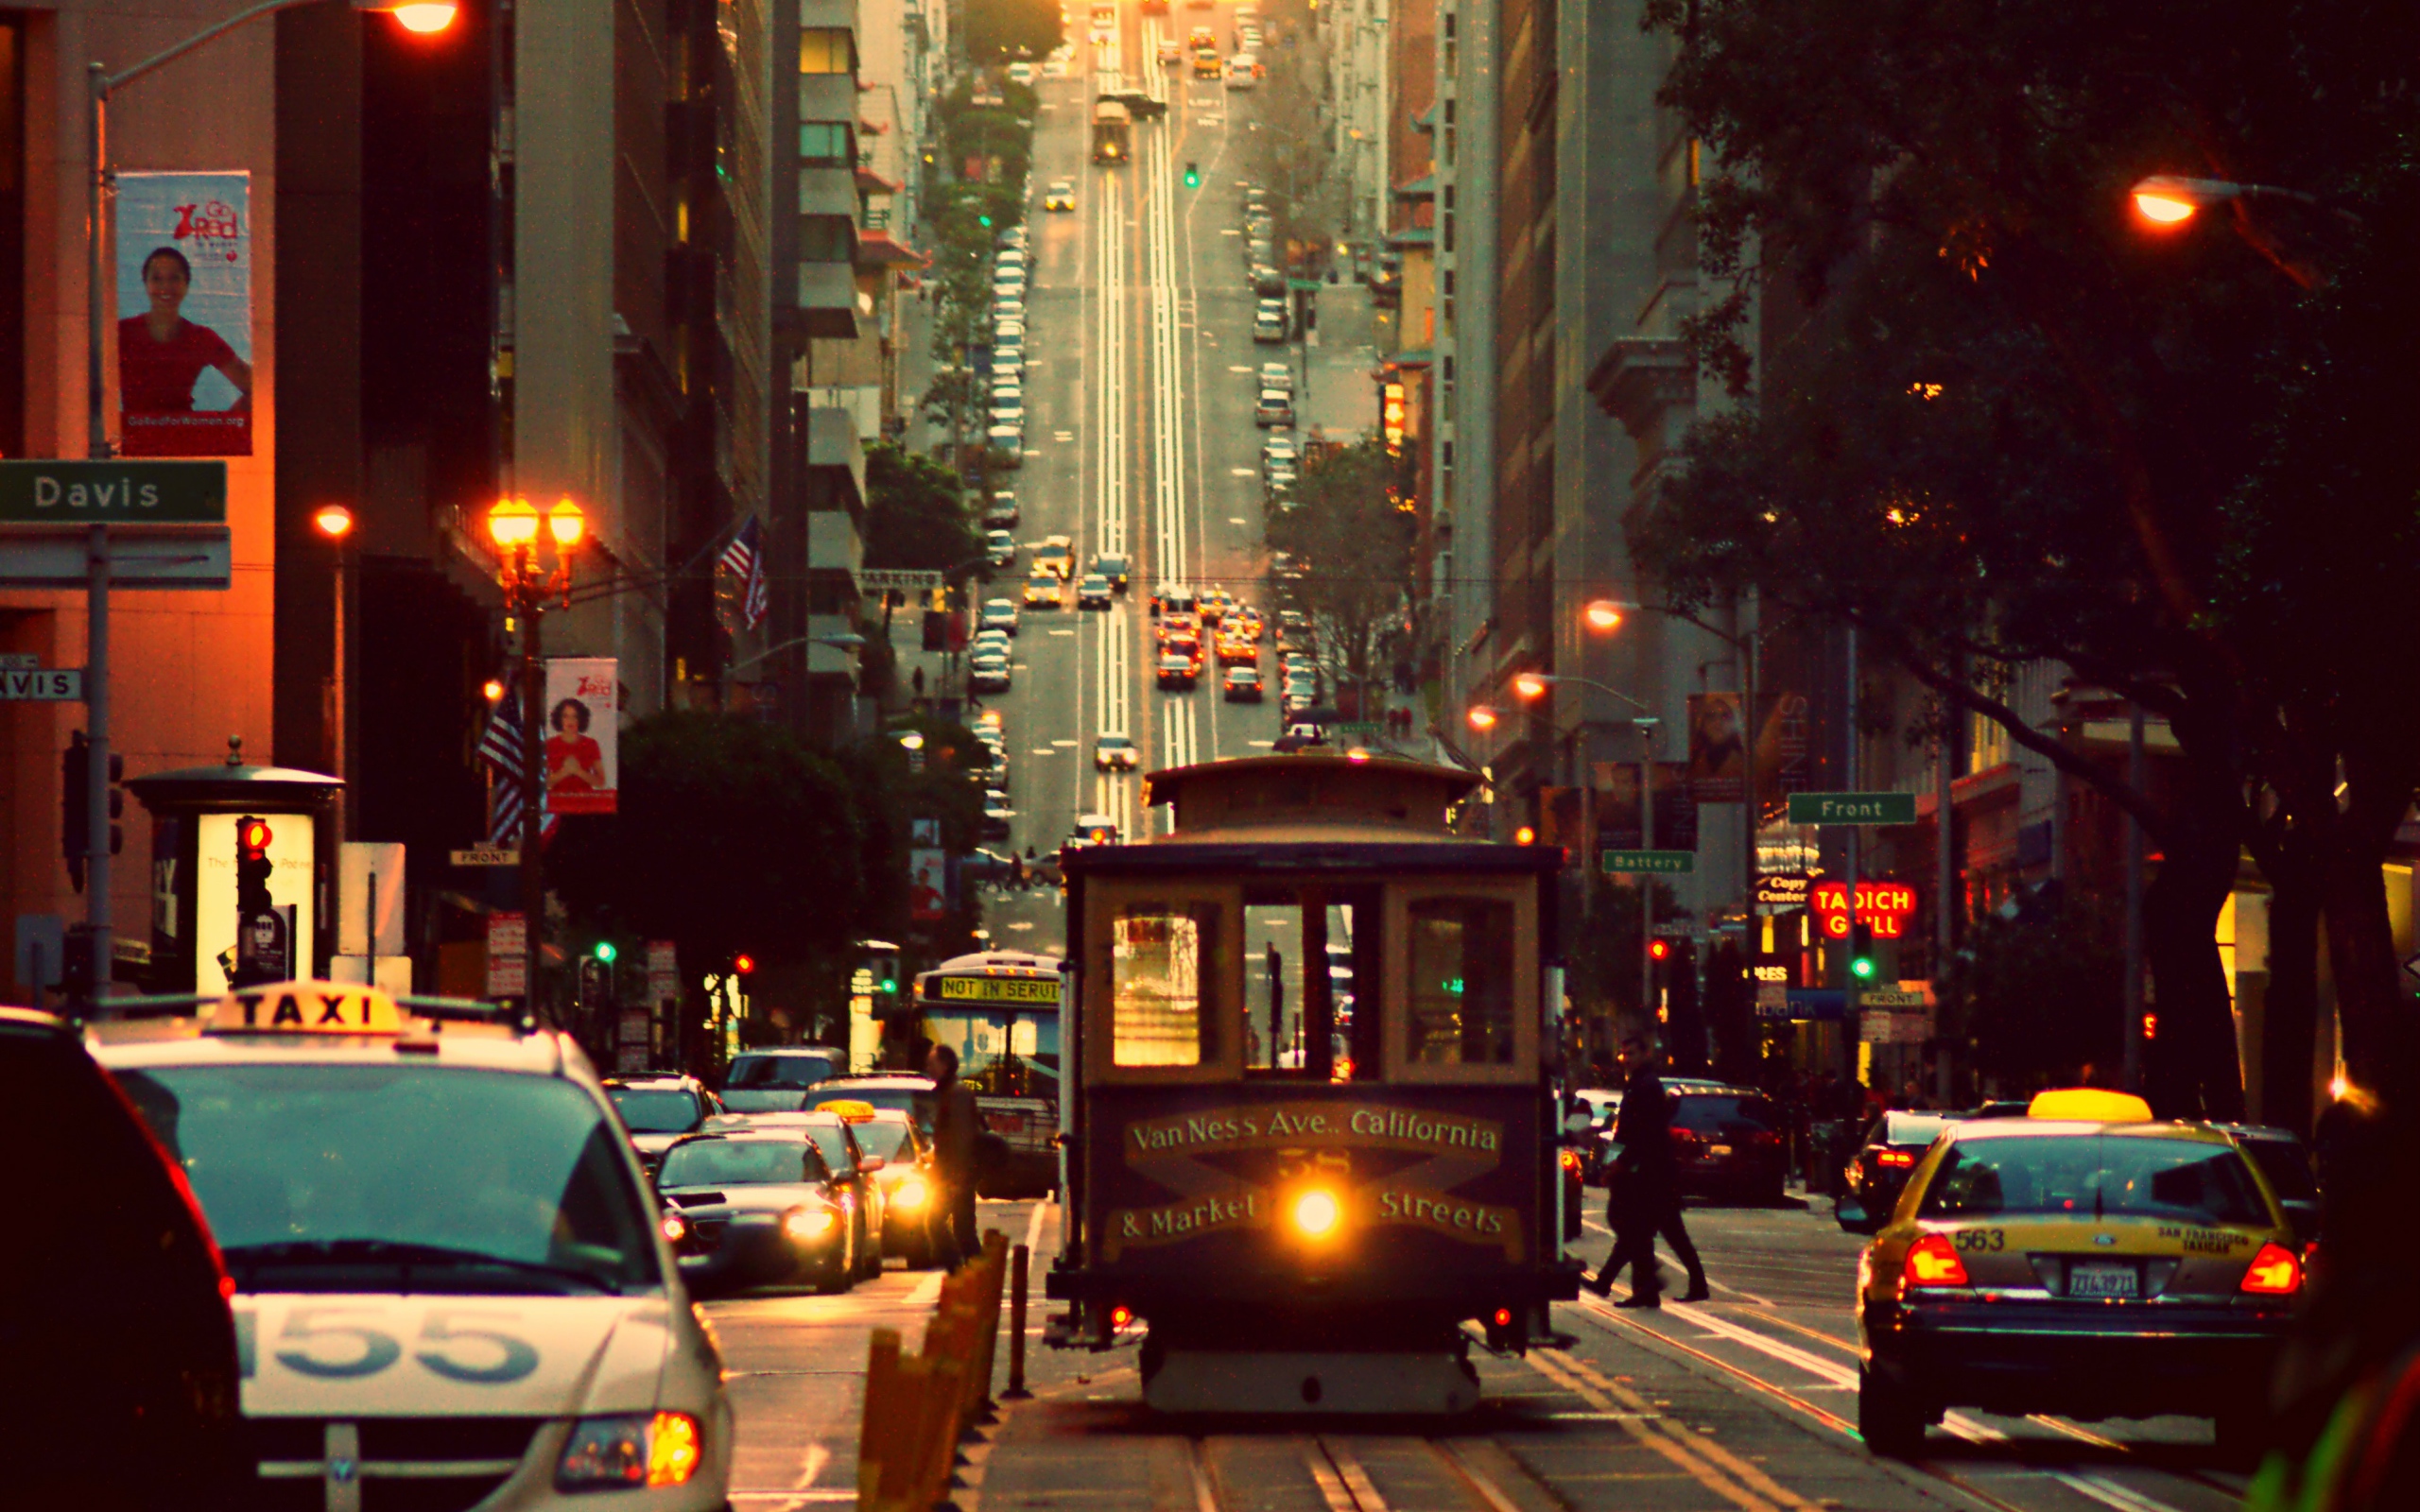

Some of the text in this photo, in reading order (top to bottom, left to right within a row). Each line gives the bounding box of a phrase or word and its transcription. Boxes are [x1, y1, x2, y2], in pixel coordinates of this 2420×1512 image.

[195, 213, 237, 240] Red
[34, 475, 159, 507] Davis
[1822, 800, 1882, 816] Front
[461, 851, 509, 863] FRONT
[1615, 855, 1682, 869] Battery
[1770, 876, 1807, 891] Copy
[1758, 890, 1807, 902] Center
[944, 980, 976, 995] NOT
[984, 983, 1000, 997] IN
[1870, 994, 1913, 1004] FRONT
[235, 994, 372, 1025] TAXI
[1134, 1126, 1183, 1150] Van
[1187, 1117, 1257, 1143] Ness
[1351, 1109, 1495, 1150] California
[1123, 1192, 1504, 1237] & Market Streets
[1955, 1229, 2005, 1251] 563
[2158, 1227, 2249, 1246] SAN FRANCISCO
